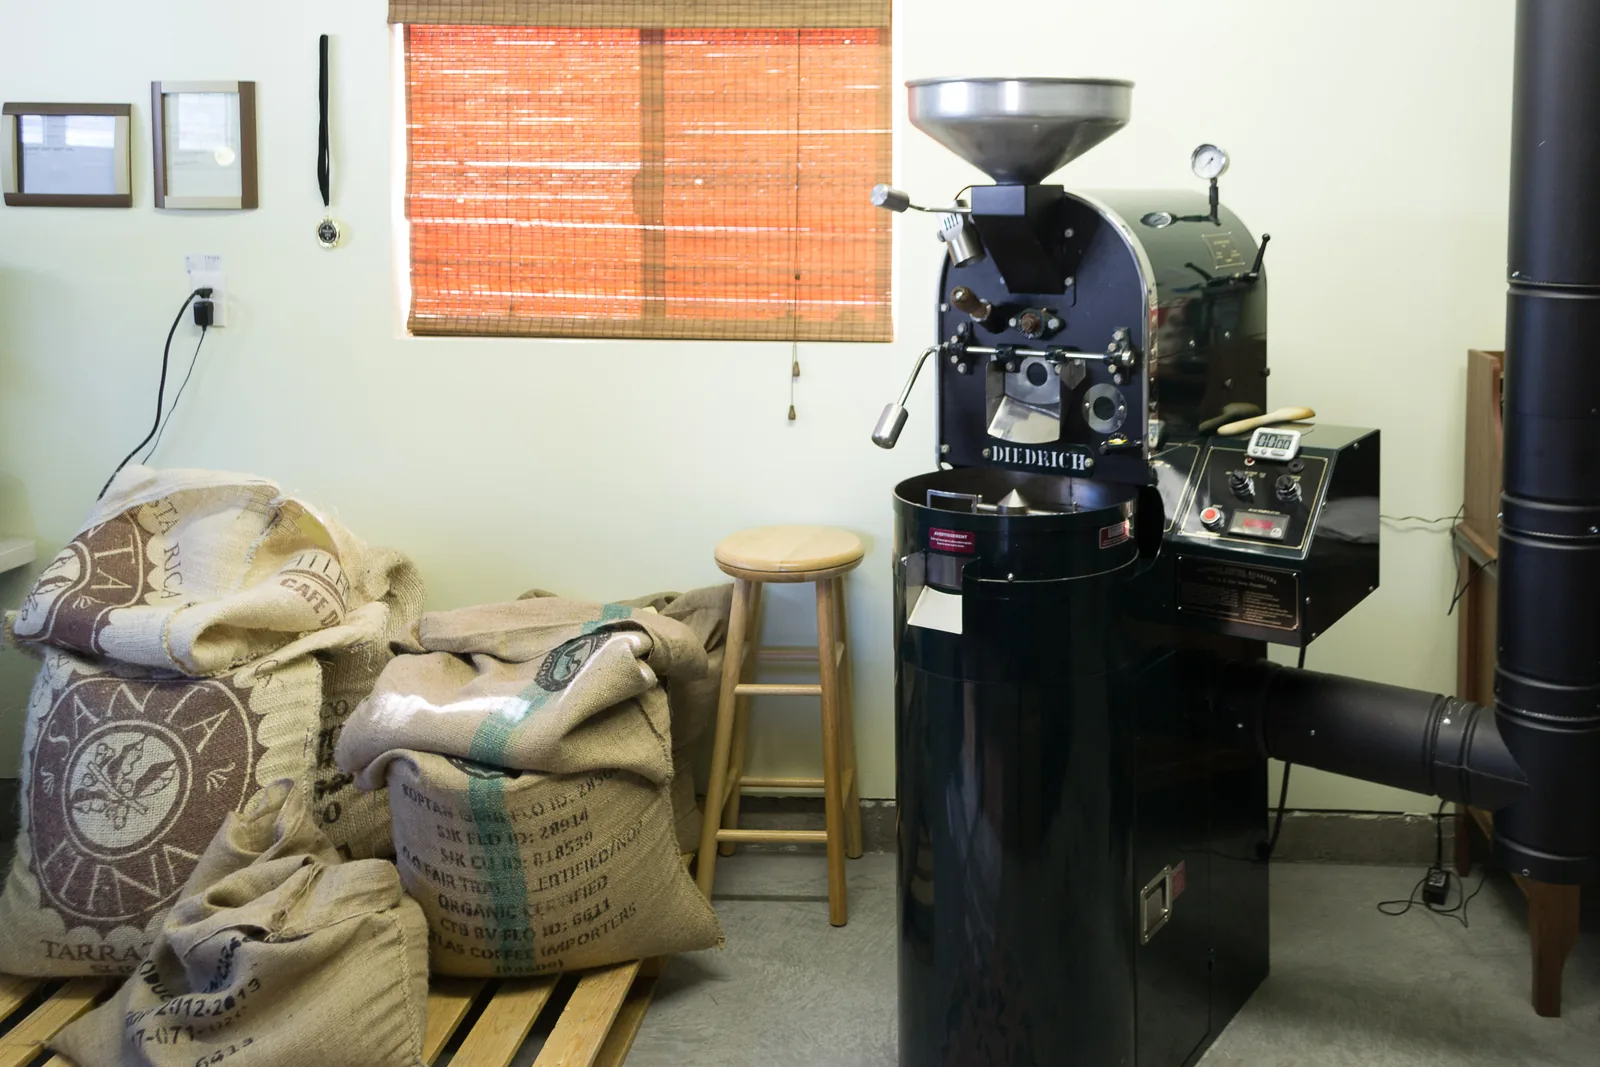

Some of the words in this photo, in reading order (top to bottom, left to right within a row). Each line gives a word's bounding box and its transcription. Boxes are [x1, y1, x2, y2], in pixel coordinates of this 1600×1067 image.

[991, 445, 1086, 472] DIEDRICH
[279, 577, 330, 614] CAFE
[49, 682, 231, 761] SANTA
[437, 892, 518, 921] ORGANIC
